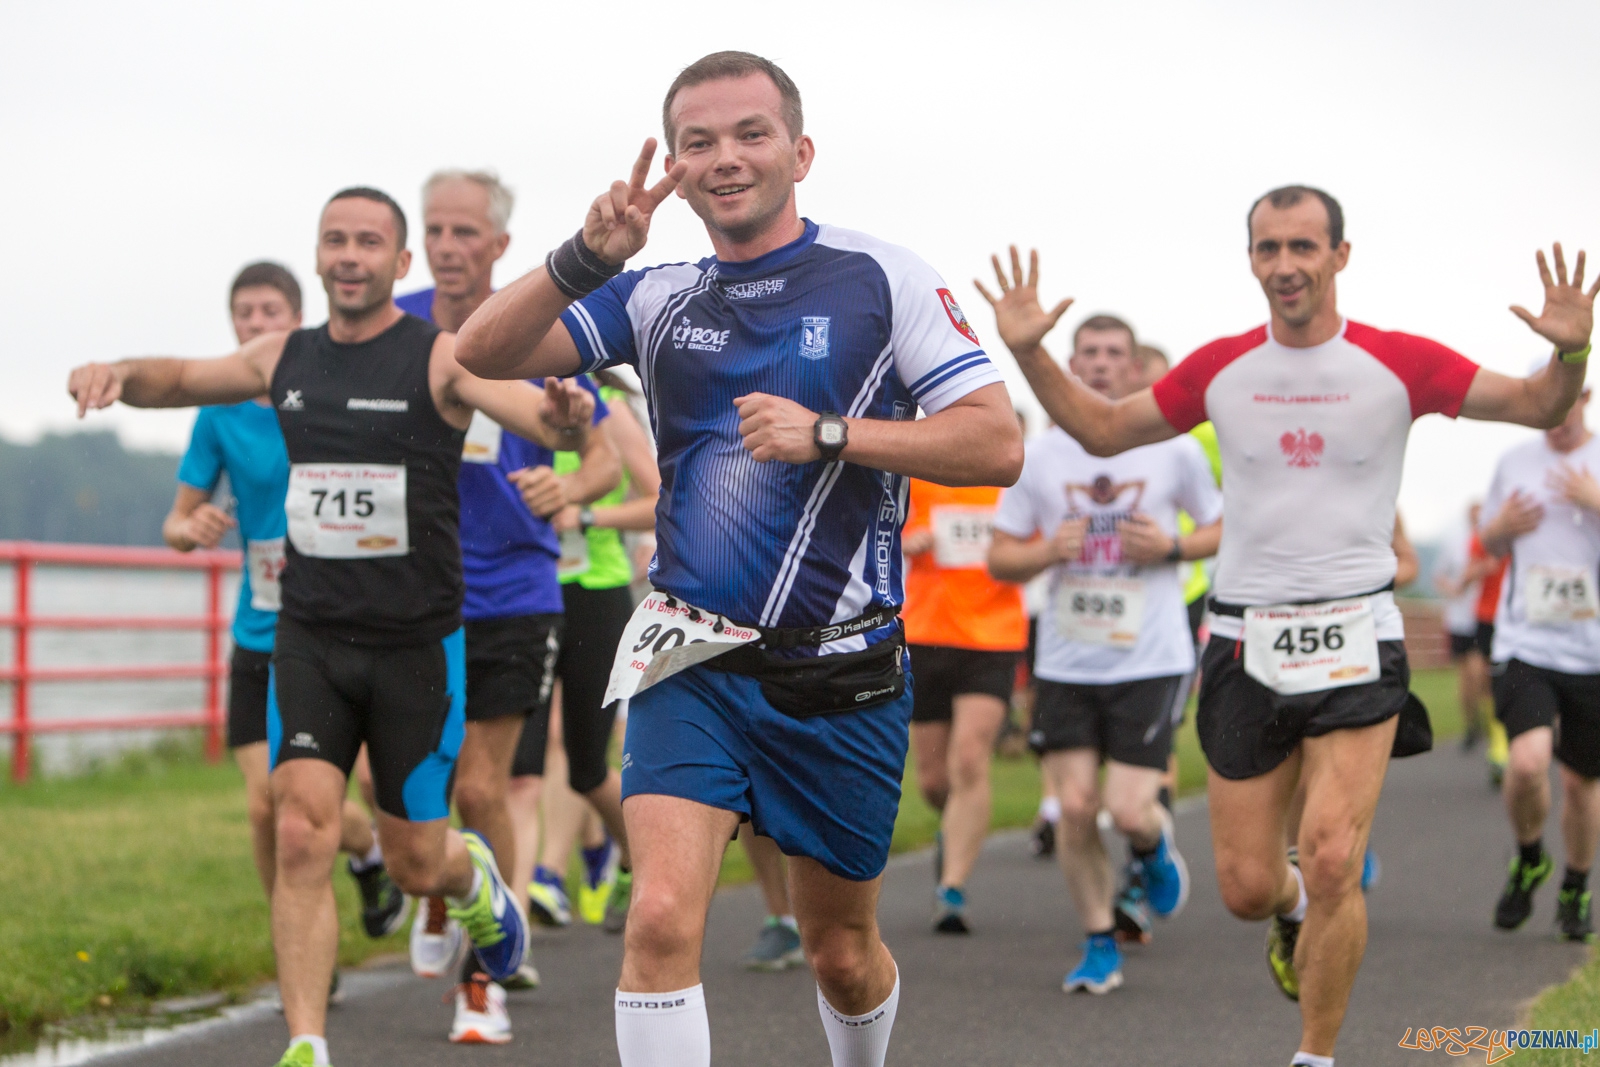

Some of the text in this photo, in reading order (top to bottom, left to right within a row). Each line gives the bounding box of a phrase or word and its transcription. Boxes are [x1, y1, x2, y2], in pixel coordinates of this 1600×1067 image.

[674, 342, 723, 352] W BIEGU
[310, 490, 375, 518] 715
[644, 599, 654, 610] IV
[724, 626, 753, 640] aweł
[844, 612, 883, 634] Kalenji
[632, 624, 708, 656] 90
[1273, 624, 1344, 655] 456
[872, 685, 895, 696] Kalenji
[618, 998, 686, 1009] moose
